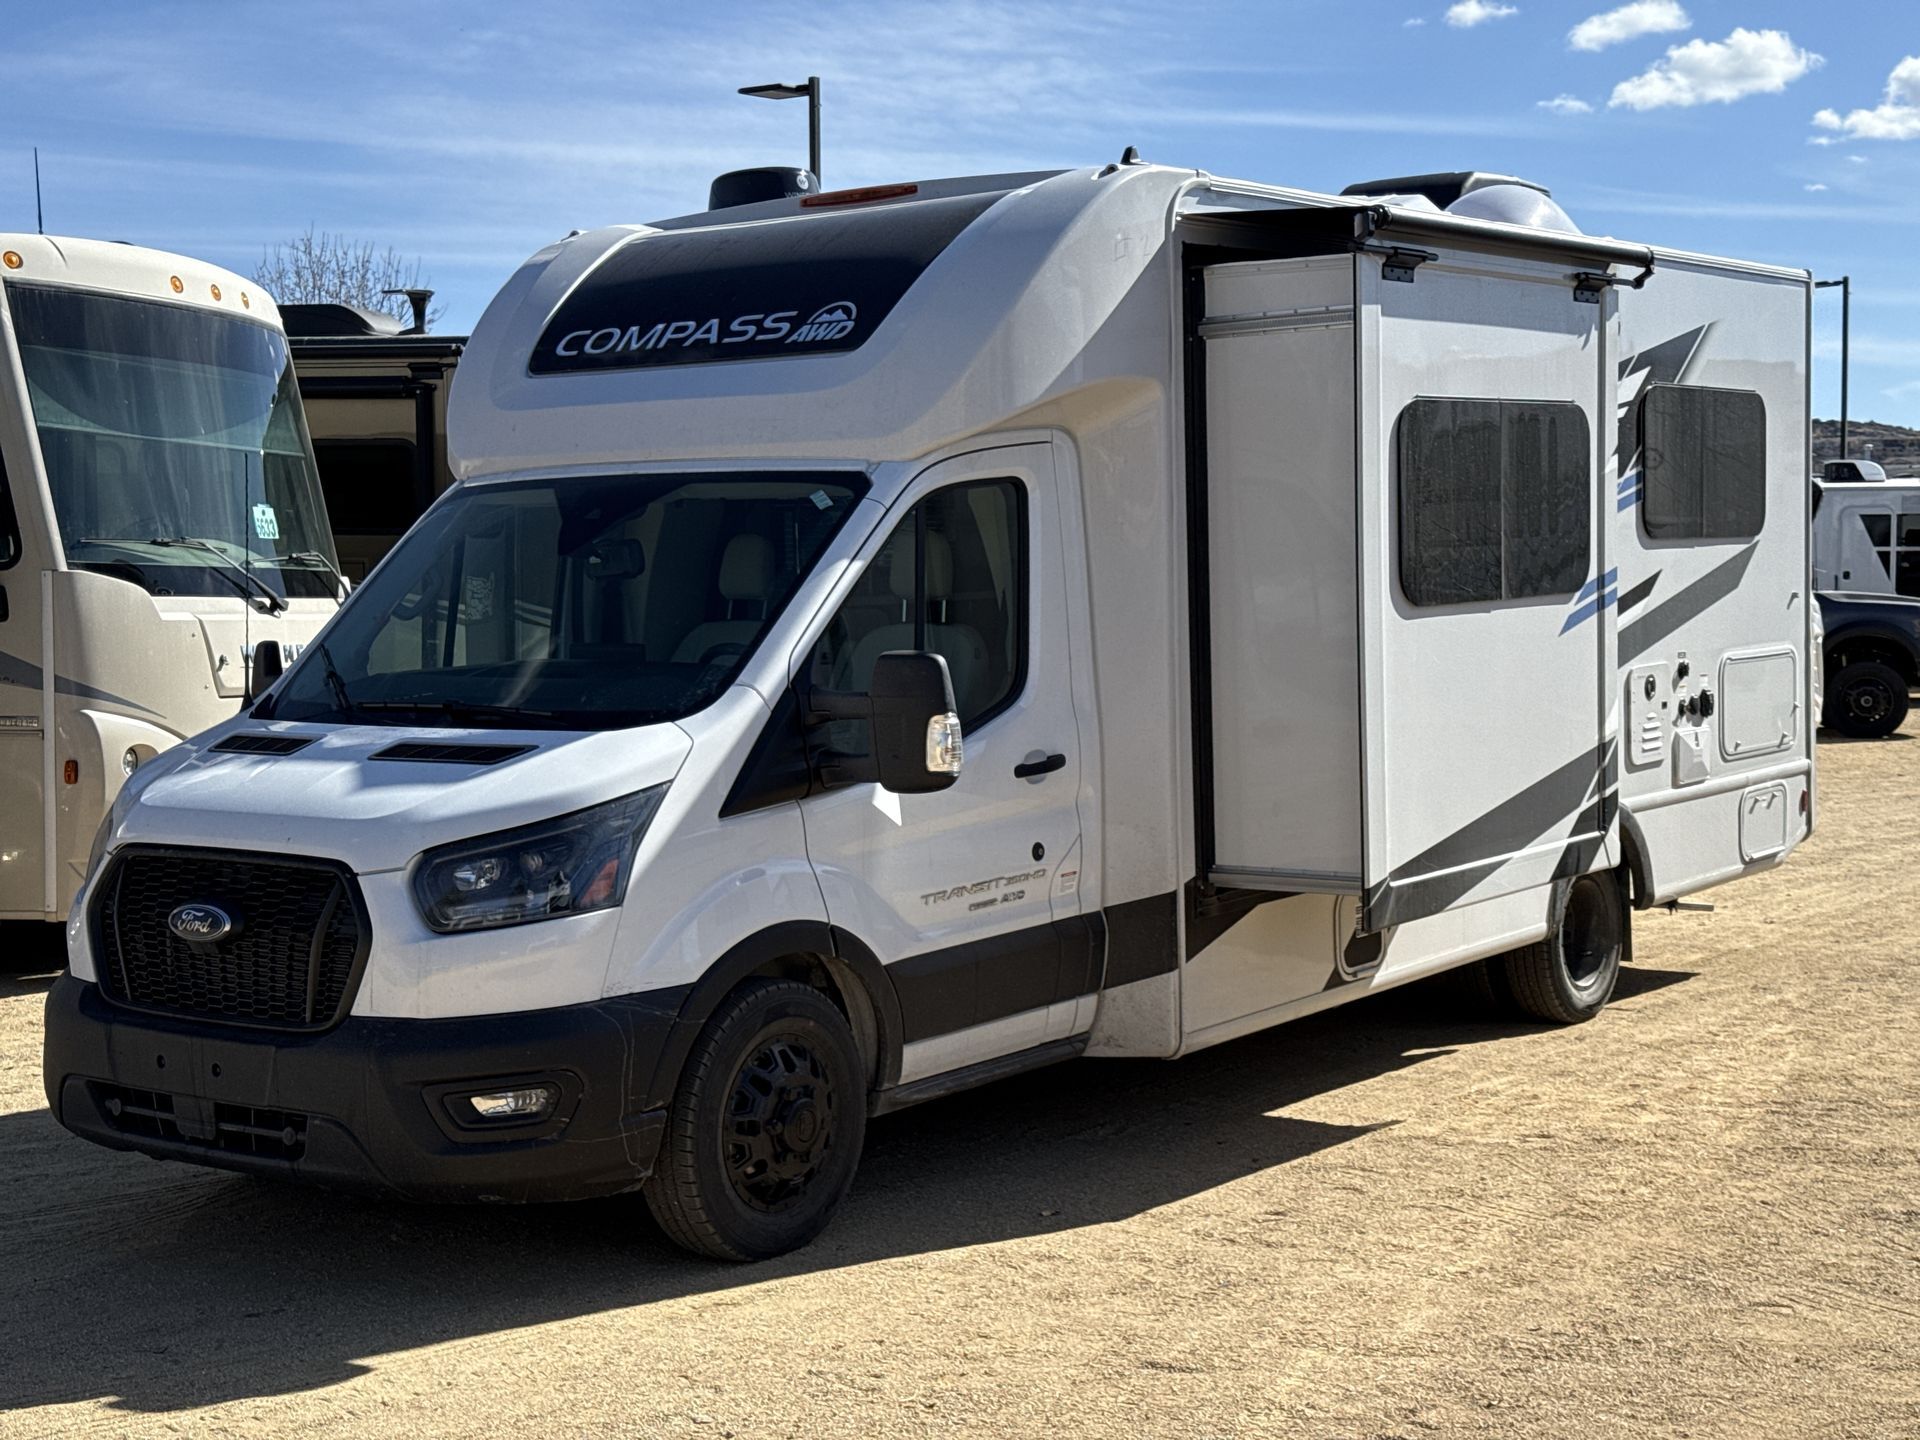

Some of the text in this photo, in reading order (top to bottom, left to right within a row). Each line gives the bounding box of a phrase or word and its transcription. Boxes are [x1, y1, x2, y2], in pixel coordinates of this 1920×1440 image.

[556, 310, 856, 356] COMPASS AWD
[920, 876, 1005, 905] TRANSIT
[177, 909, 213, 933] Ford
